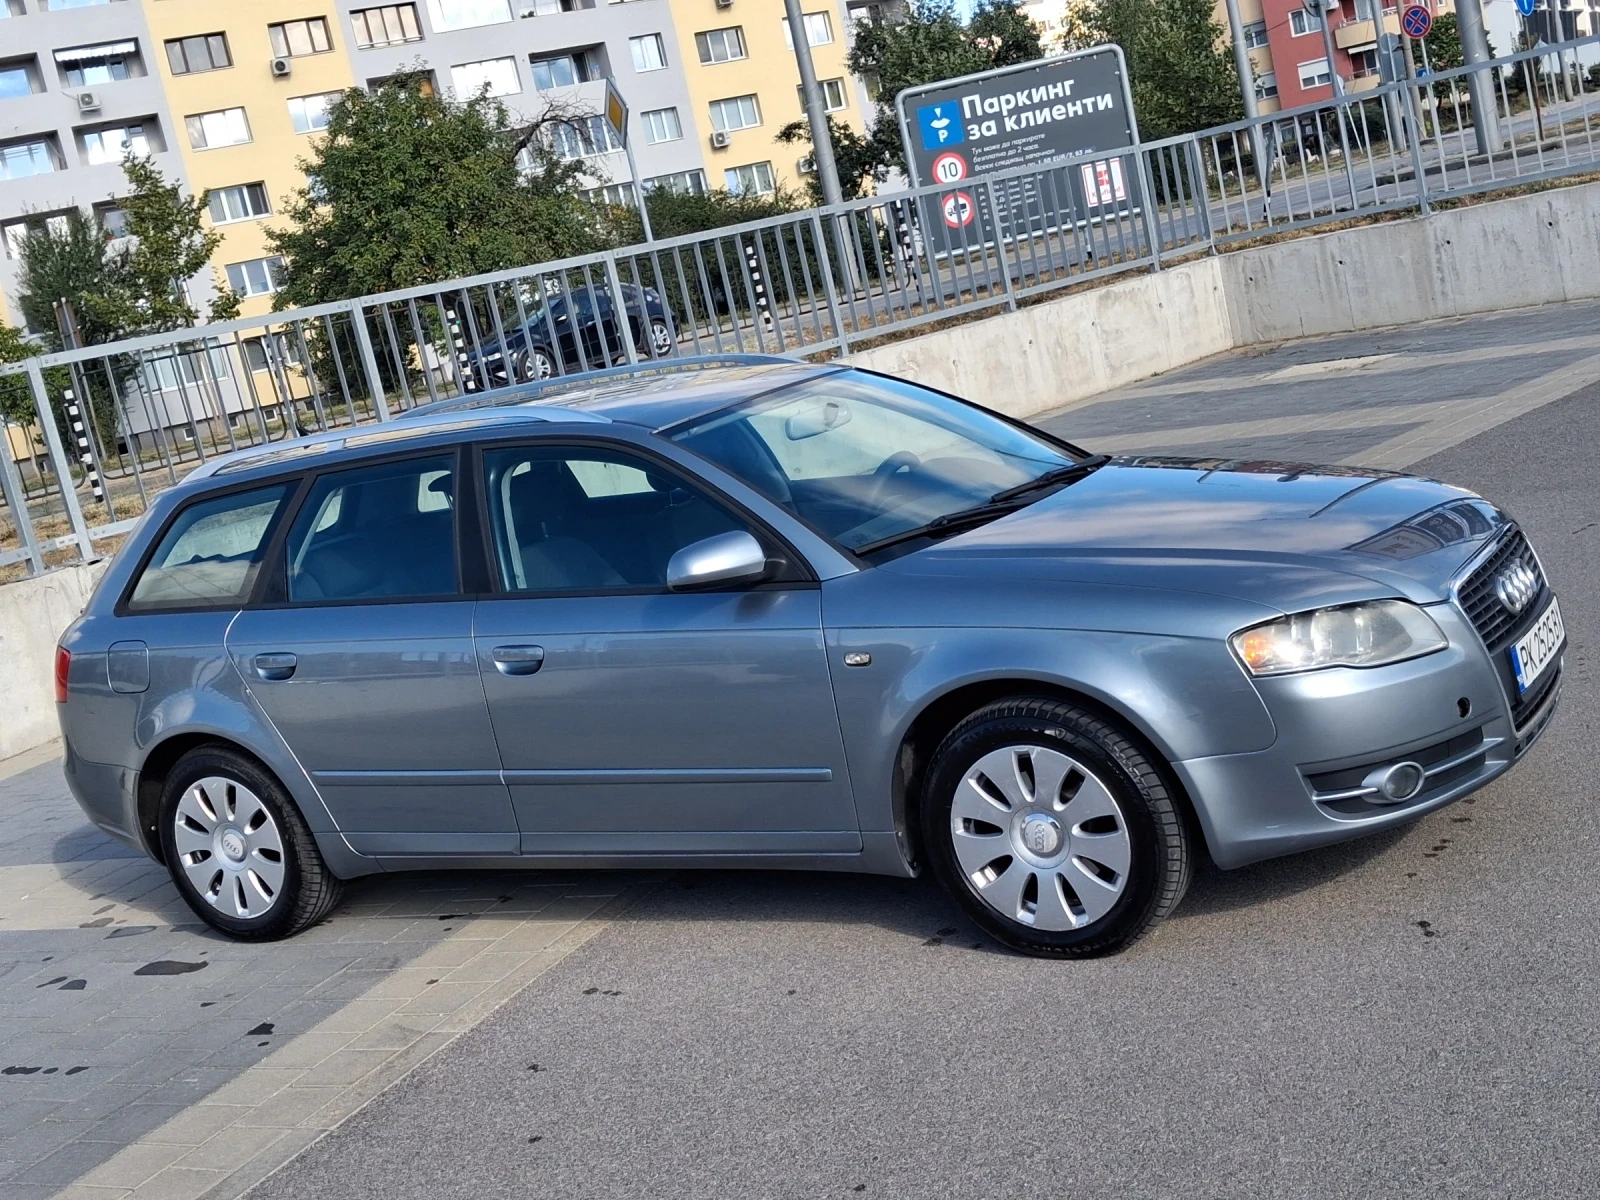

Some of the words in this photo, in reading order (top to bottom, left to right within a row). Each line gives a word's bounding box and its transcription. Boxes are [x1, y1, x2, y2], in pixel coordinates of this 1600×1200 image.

[962, 79, 1075, 119] Паркинг
[967, 121, 998, 141] за
[1004, 93, 1114, 132] клиенти
[1001, 141, 1011, 149] да
[1011, 133, 1046, 146] паркирате
[973, 152, 1007, 163] безплатно
[974, 163, 994, 172] Всеки
[994, 156, 1024, 167] следващ
[941, 162, 958, 179] 10
